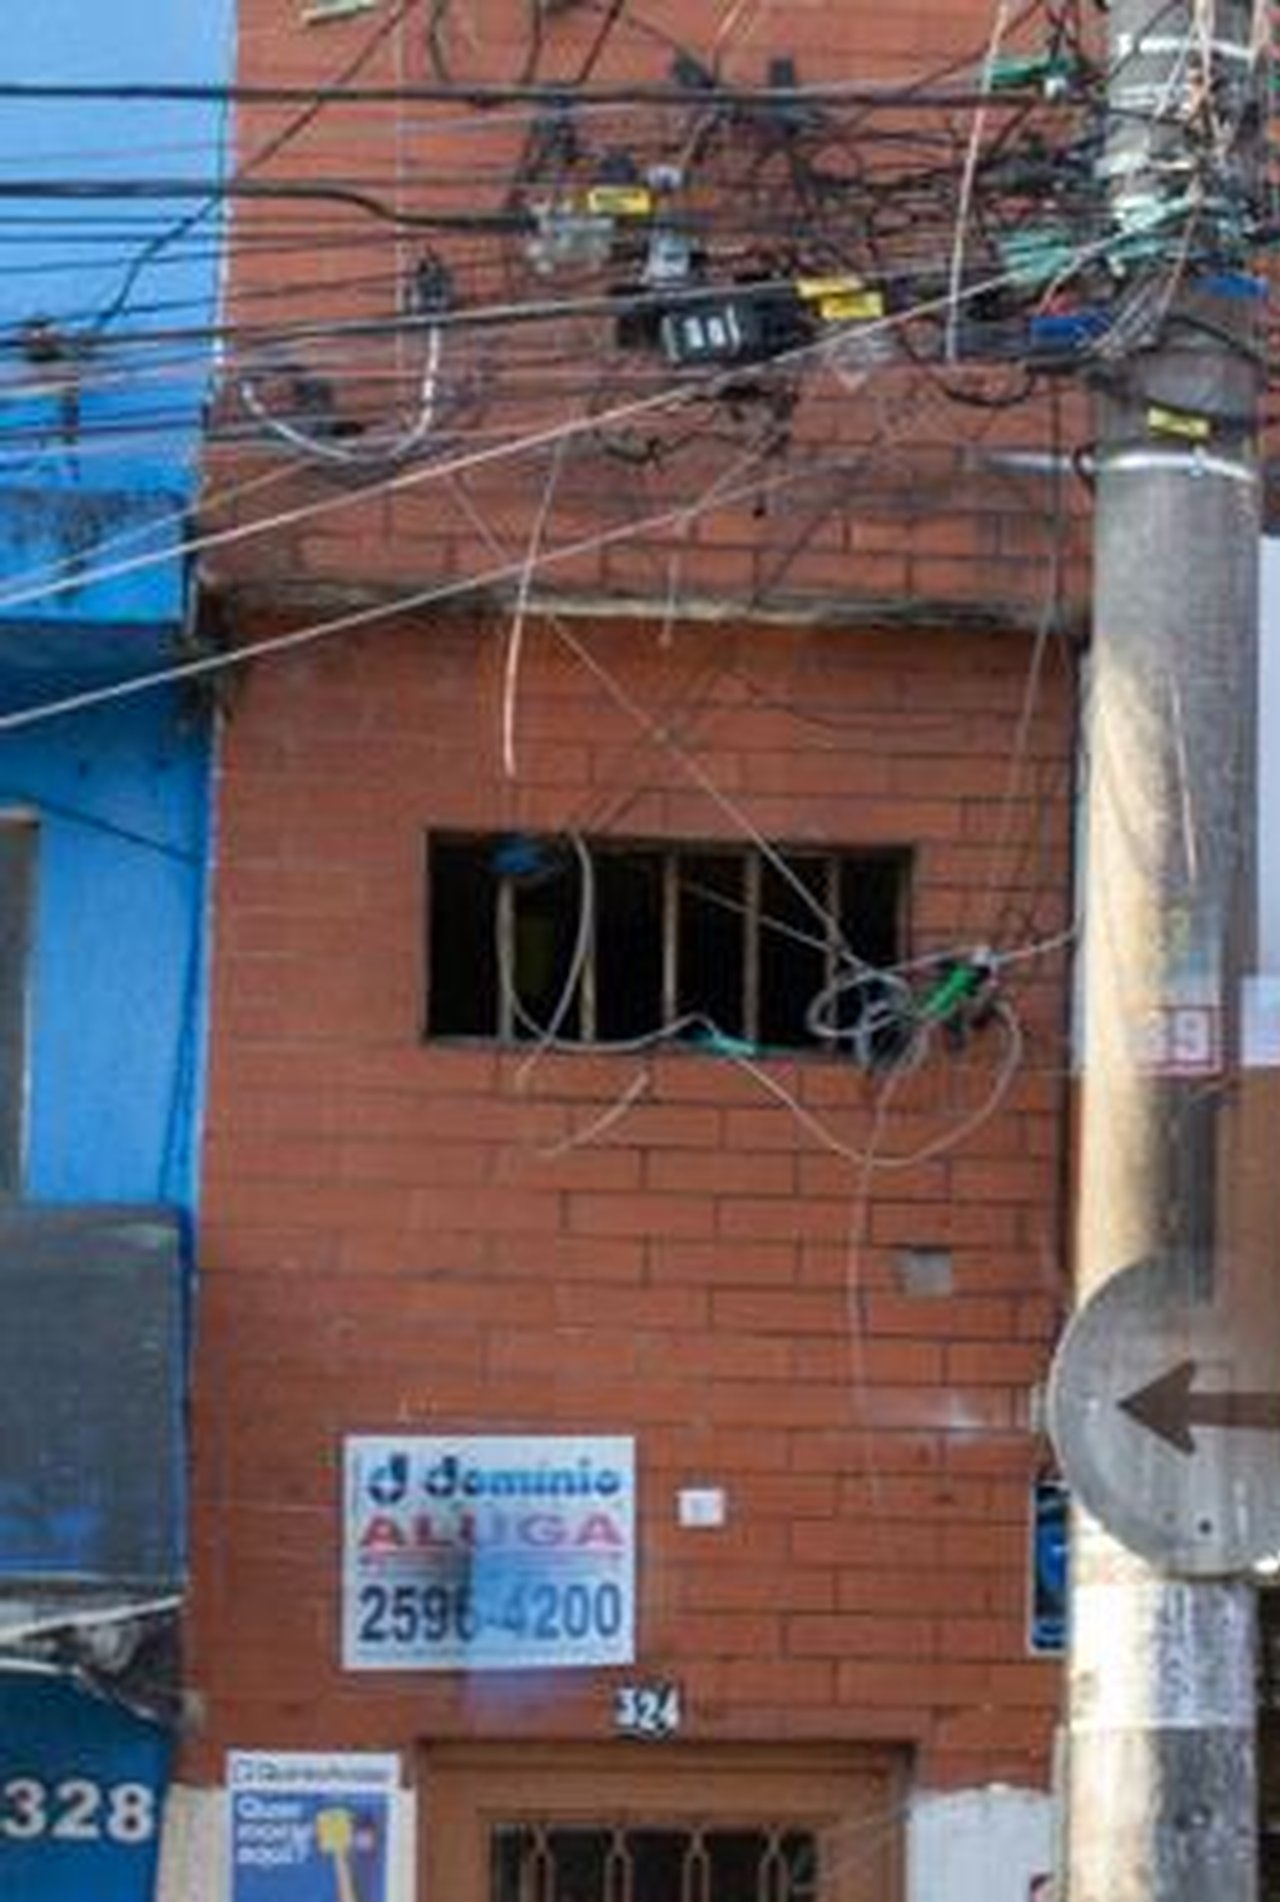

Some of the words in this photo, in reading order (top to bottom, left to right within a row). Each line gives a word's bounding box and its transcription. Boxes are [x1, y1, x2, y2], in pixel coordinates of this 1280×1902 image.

[359, 1512, 624, 1548] ALUGA
[358, 1582, 623, 1642] 2596-4200
[2, 1779, 153, 1843] 328
